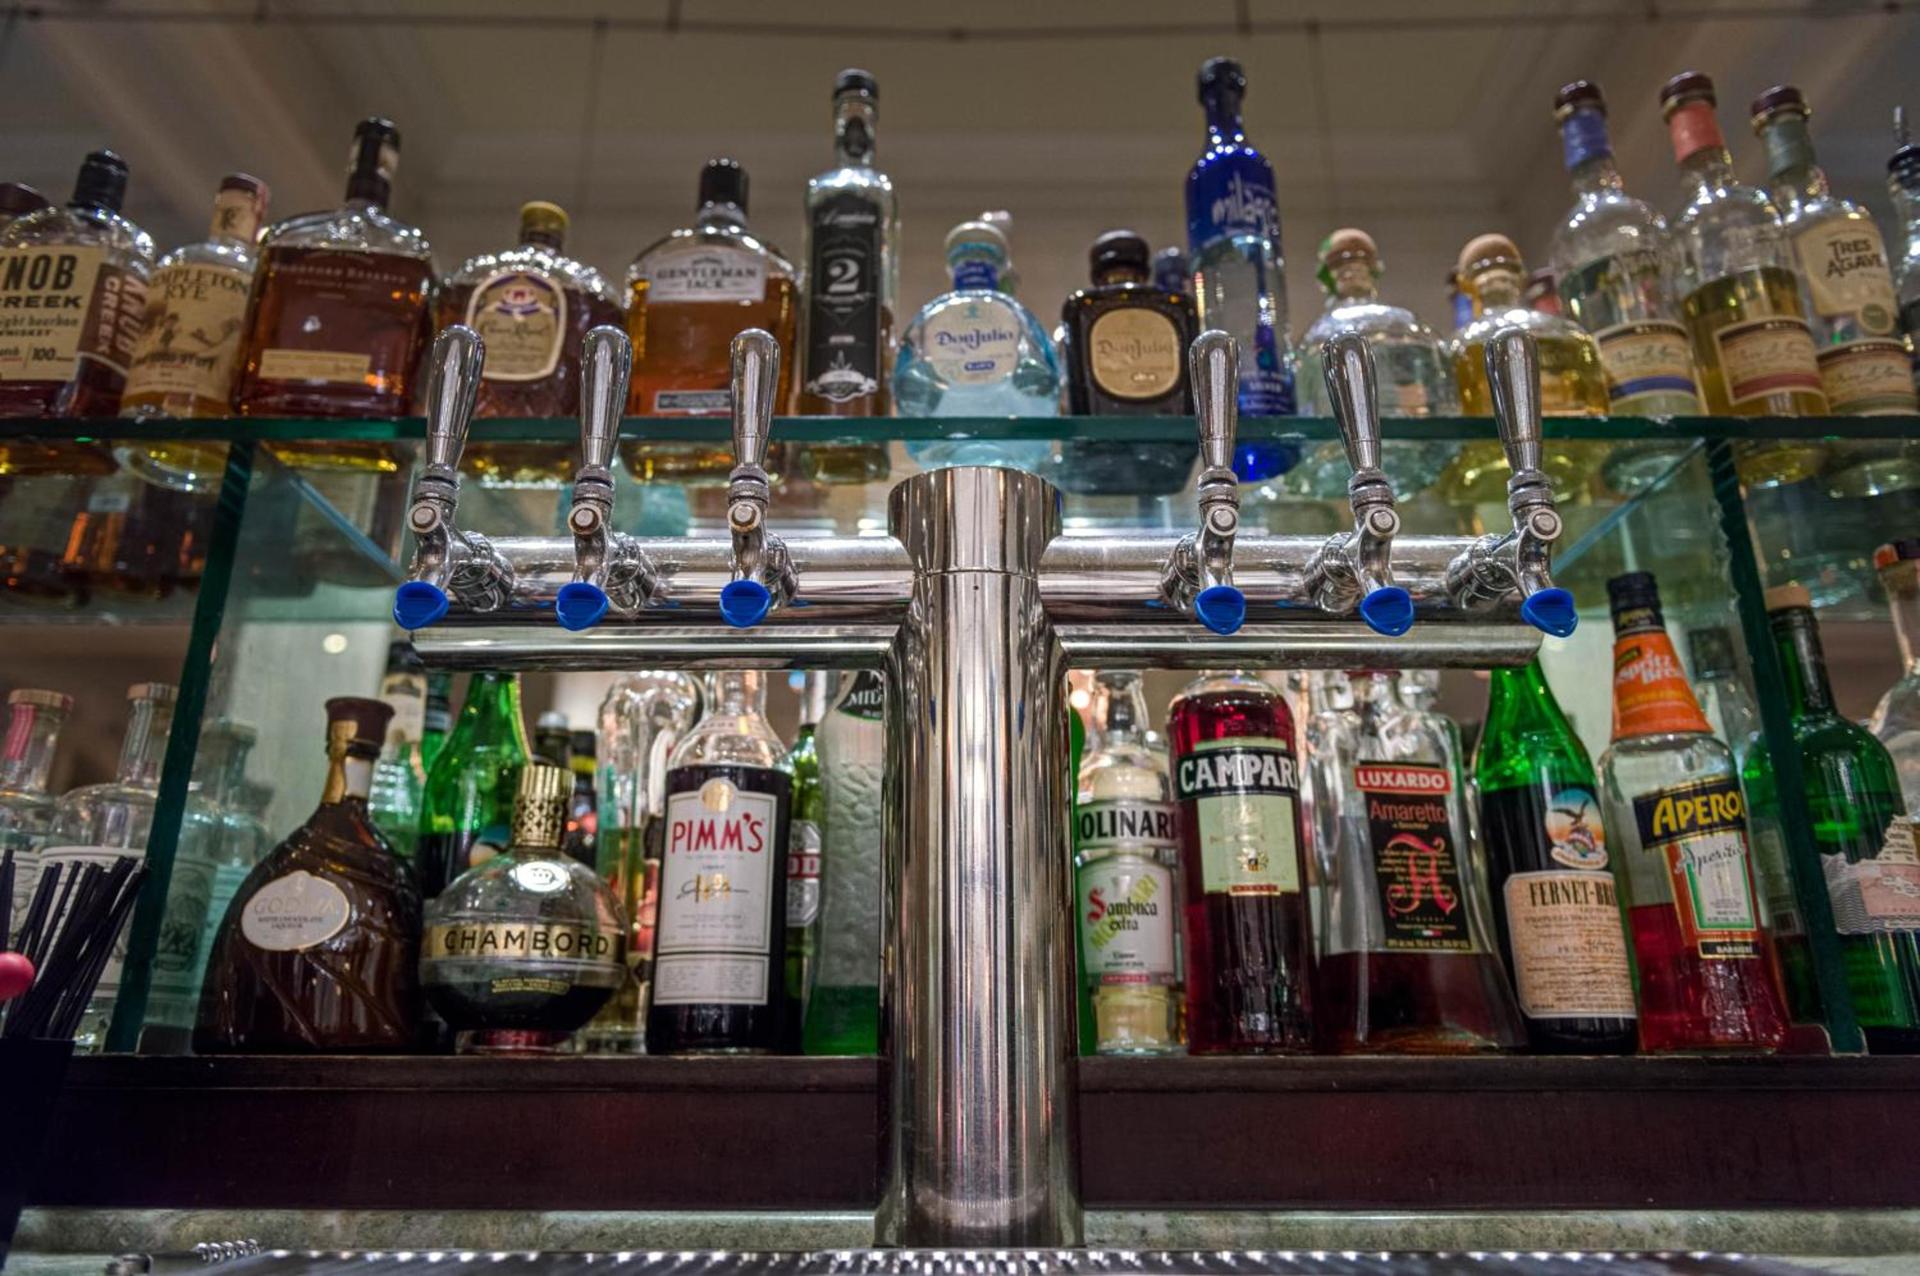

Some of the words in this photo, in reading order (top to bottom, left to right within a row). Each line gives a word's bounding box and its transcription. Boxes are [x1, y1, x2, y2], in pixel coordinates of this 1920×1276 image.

[1827, 239, 1872, 259] TRES
[657, 268, 757, 279] GENTLEMAN
[828, 258, 860, 292] 2
[0, 295, 82, 309] REEK
[1180, 753, 1299, 793] CAMPARI
[1357, 770, 1446, 789] LUXARDO
[1077, 809, 1176, 840] OLINARI
[1370, 800, 1448, 823] Amaretto
[671, 811, 764, 855] PIMM'S
[1087, 886, 1158, 923] Sambuca
[443, 929, 610, 956] CHAMBORD
